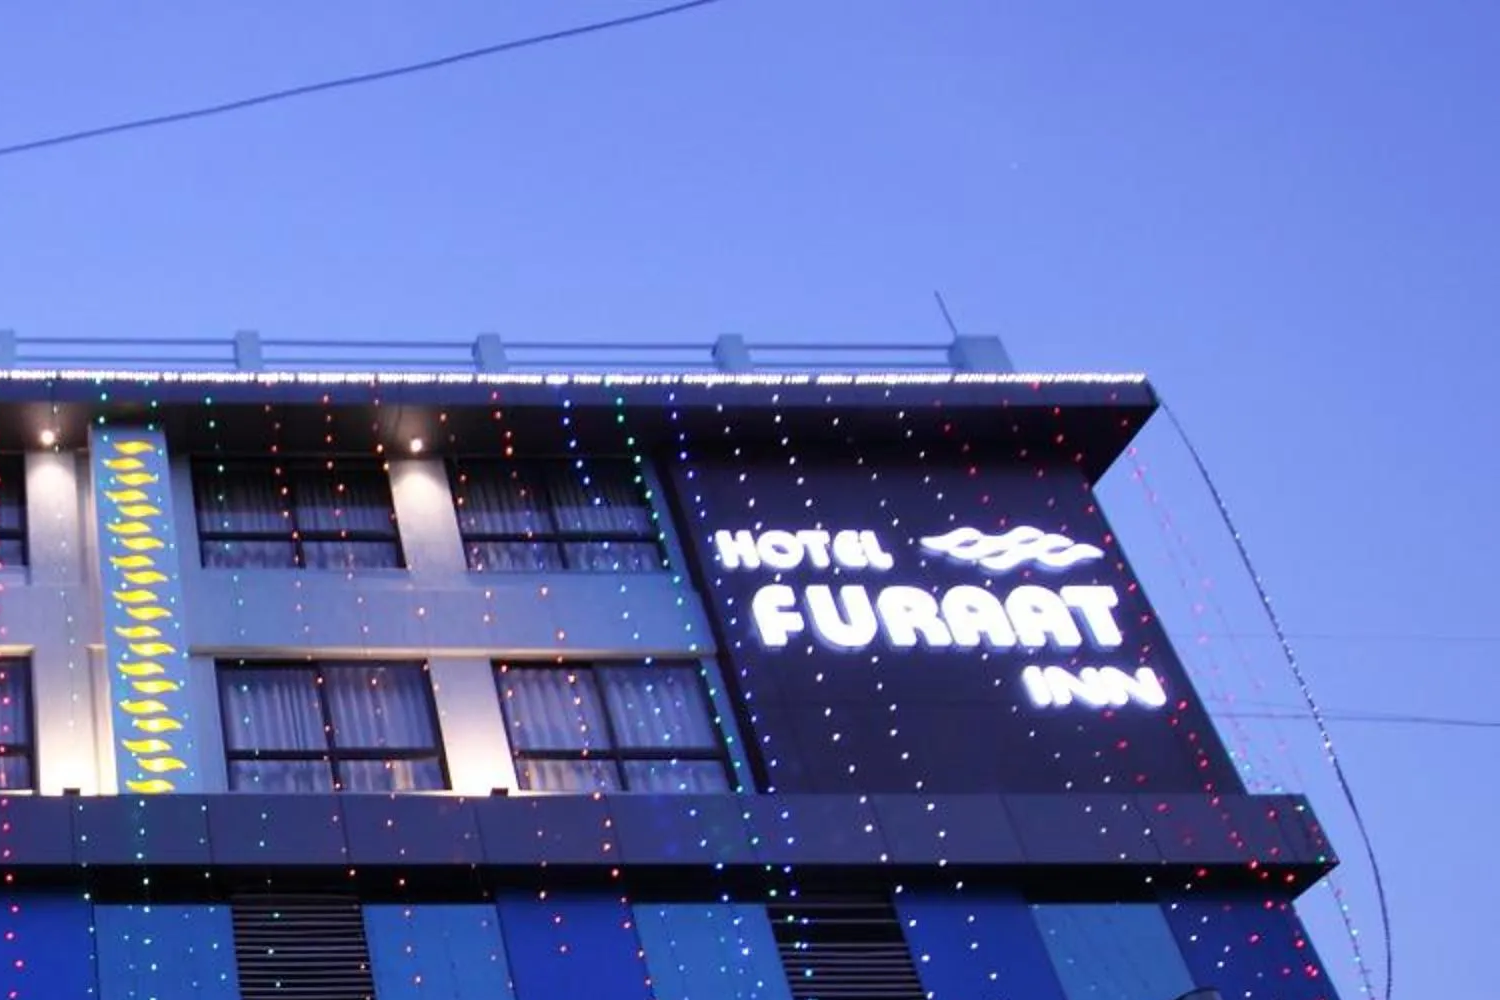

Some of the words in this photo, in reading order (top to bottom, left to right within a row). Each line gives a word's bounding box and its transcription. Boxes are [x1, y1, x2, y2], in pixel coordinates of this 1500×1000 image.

[714, 529, 894, 570] HOTEL
[751, 584, 1123, 649] FURAAT
[1021, 665, 1167, 707] INN
